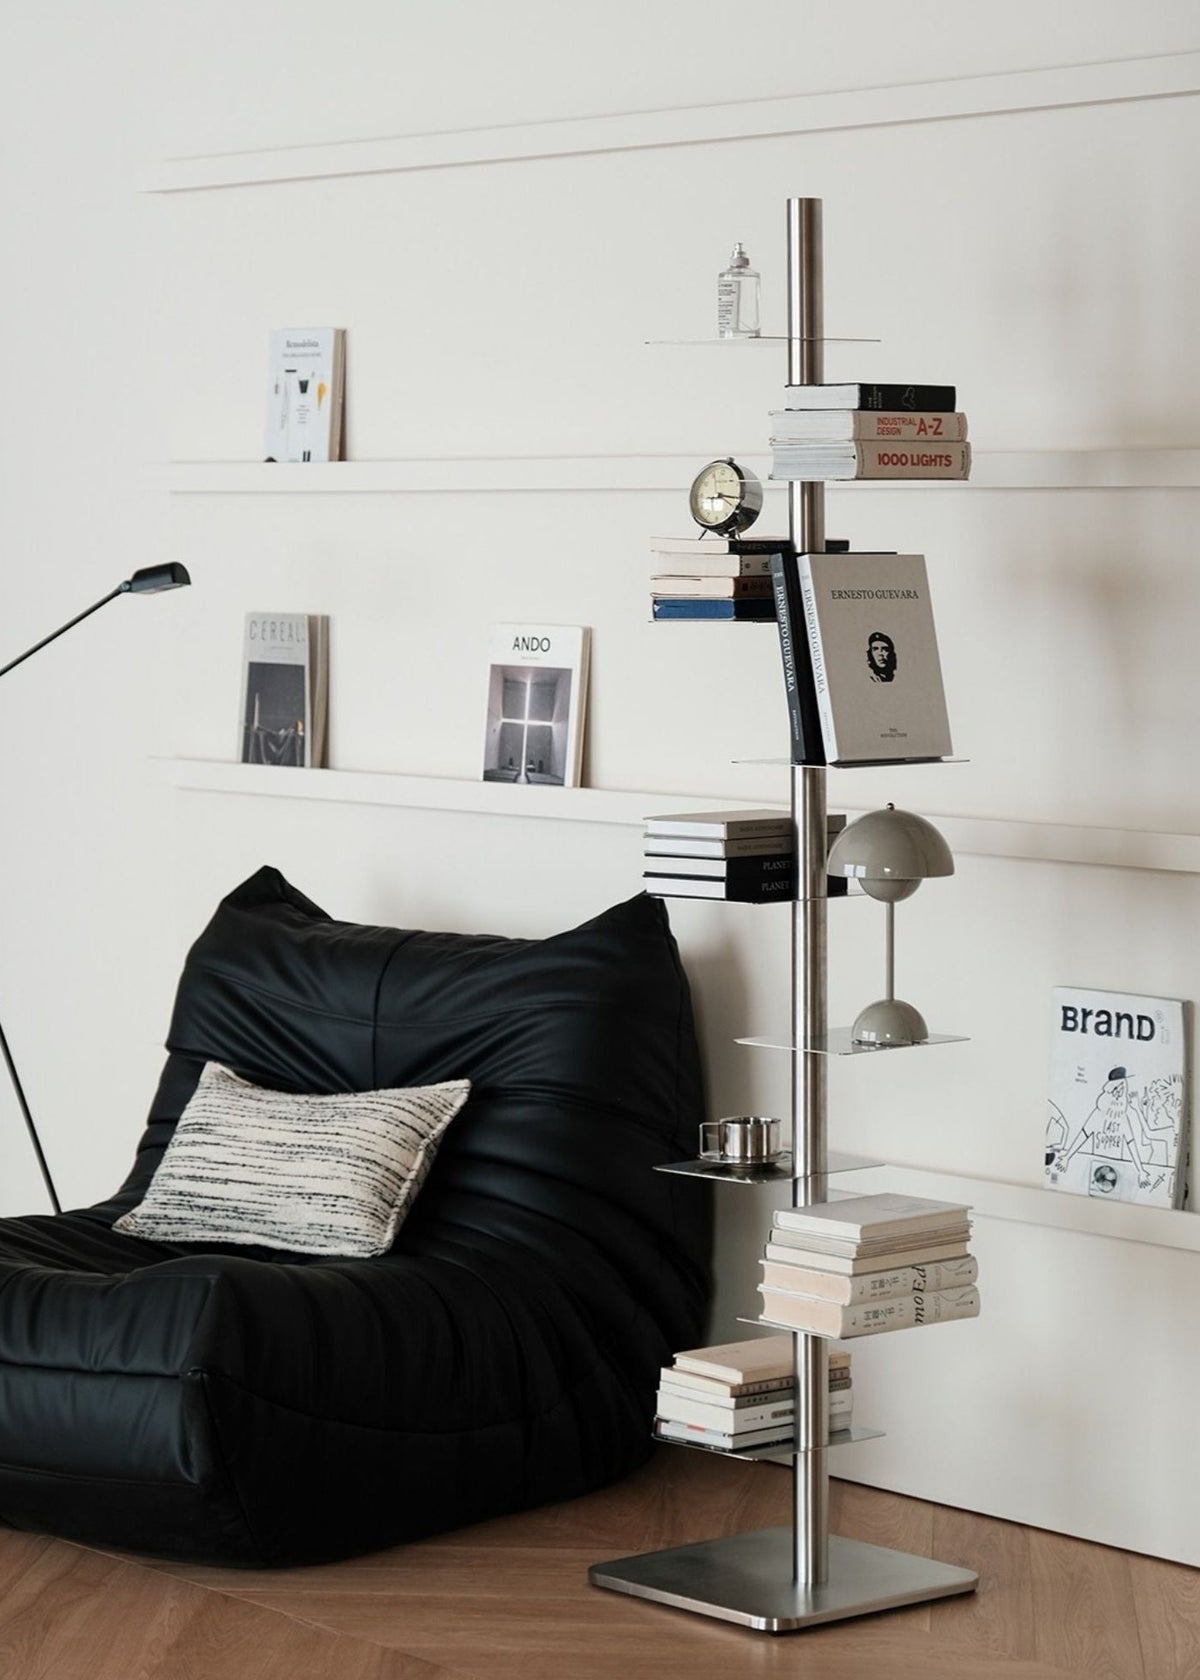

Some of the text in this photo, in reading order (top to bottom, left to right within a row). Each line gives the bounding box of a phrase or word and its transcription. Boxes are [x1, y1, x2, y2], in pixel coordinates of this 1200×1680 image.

[876, 417, 917, 426] INDUSTRIAL
[916, 417, 943, 436] A-Z
[876, 427, 902, 436] DESIGN
[877, 453, 909, 466] 1000
[910, 453, 952, 467] LIGHTS
[831, 589, 919, 600] ERNESTO GUEVARA
[804, 588, 817, 638] ERNESTO
[512, 636, 551, 653] ANDO
[776, 586, 795, 692] ERNESTO GUEVARA
[810, 640, 825, 694] GUEVARA
